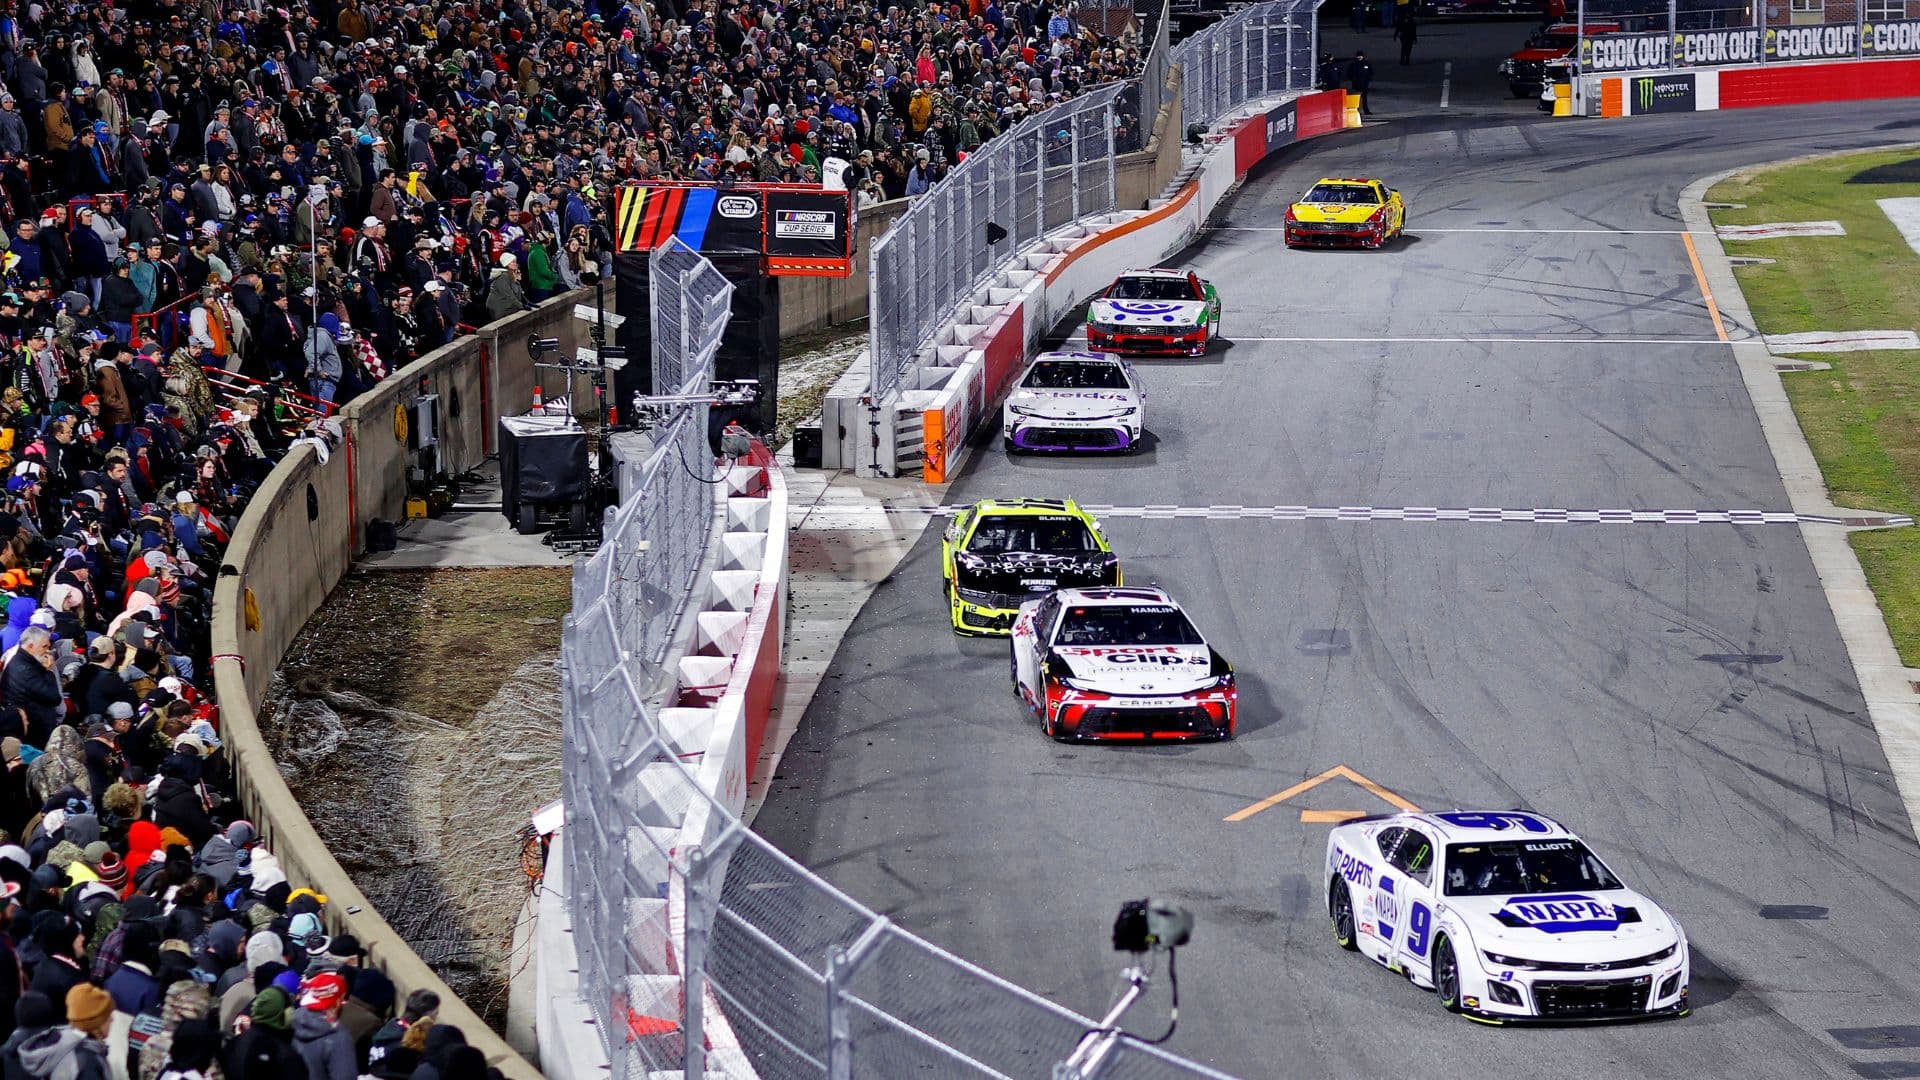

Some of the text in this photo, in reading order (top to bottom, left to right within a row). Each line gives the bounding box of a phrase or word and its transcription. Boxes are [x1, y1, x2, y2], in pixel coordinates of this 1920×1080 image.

[1776, 26, 1857, 57] COOK OUT
[1873, 22, 1920, 51] COOK
[1592, 36, 1668, 68] COOK OUT
[1685, 30, 1759, 62] COOK OUT
[1654, 83, 1689, 93] MONSTER
[795, 213, 827, 222] NASCAR
[784, 224, 827, 233] CUP SERIES
[975, 566, 1102, 578] FLOORING
[965, 604, 977, 613] 12
[1064, 646, 1178, 657] Sport
[1093, 665, 1192, 674] HAIRCUTS
[1525, 842, 1573, 851] ELLIOTT
[1341, 853, 1373, 889] PARTS
[1515, 902, 1608, 921] NAPA
[1407, 901, 1432, 958] 9
[1500, 970, 1514, 982] 9
